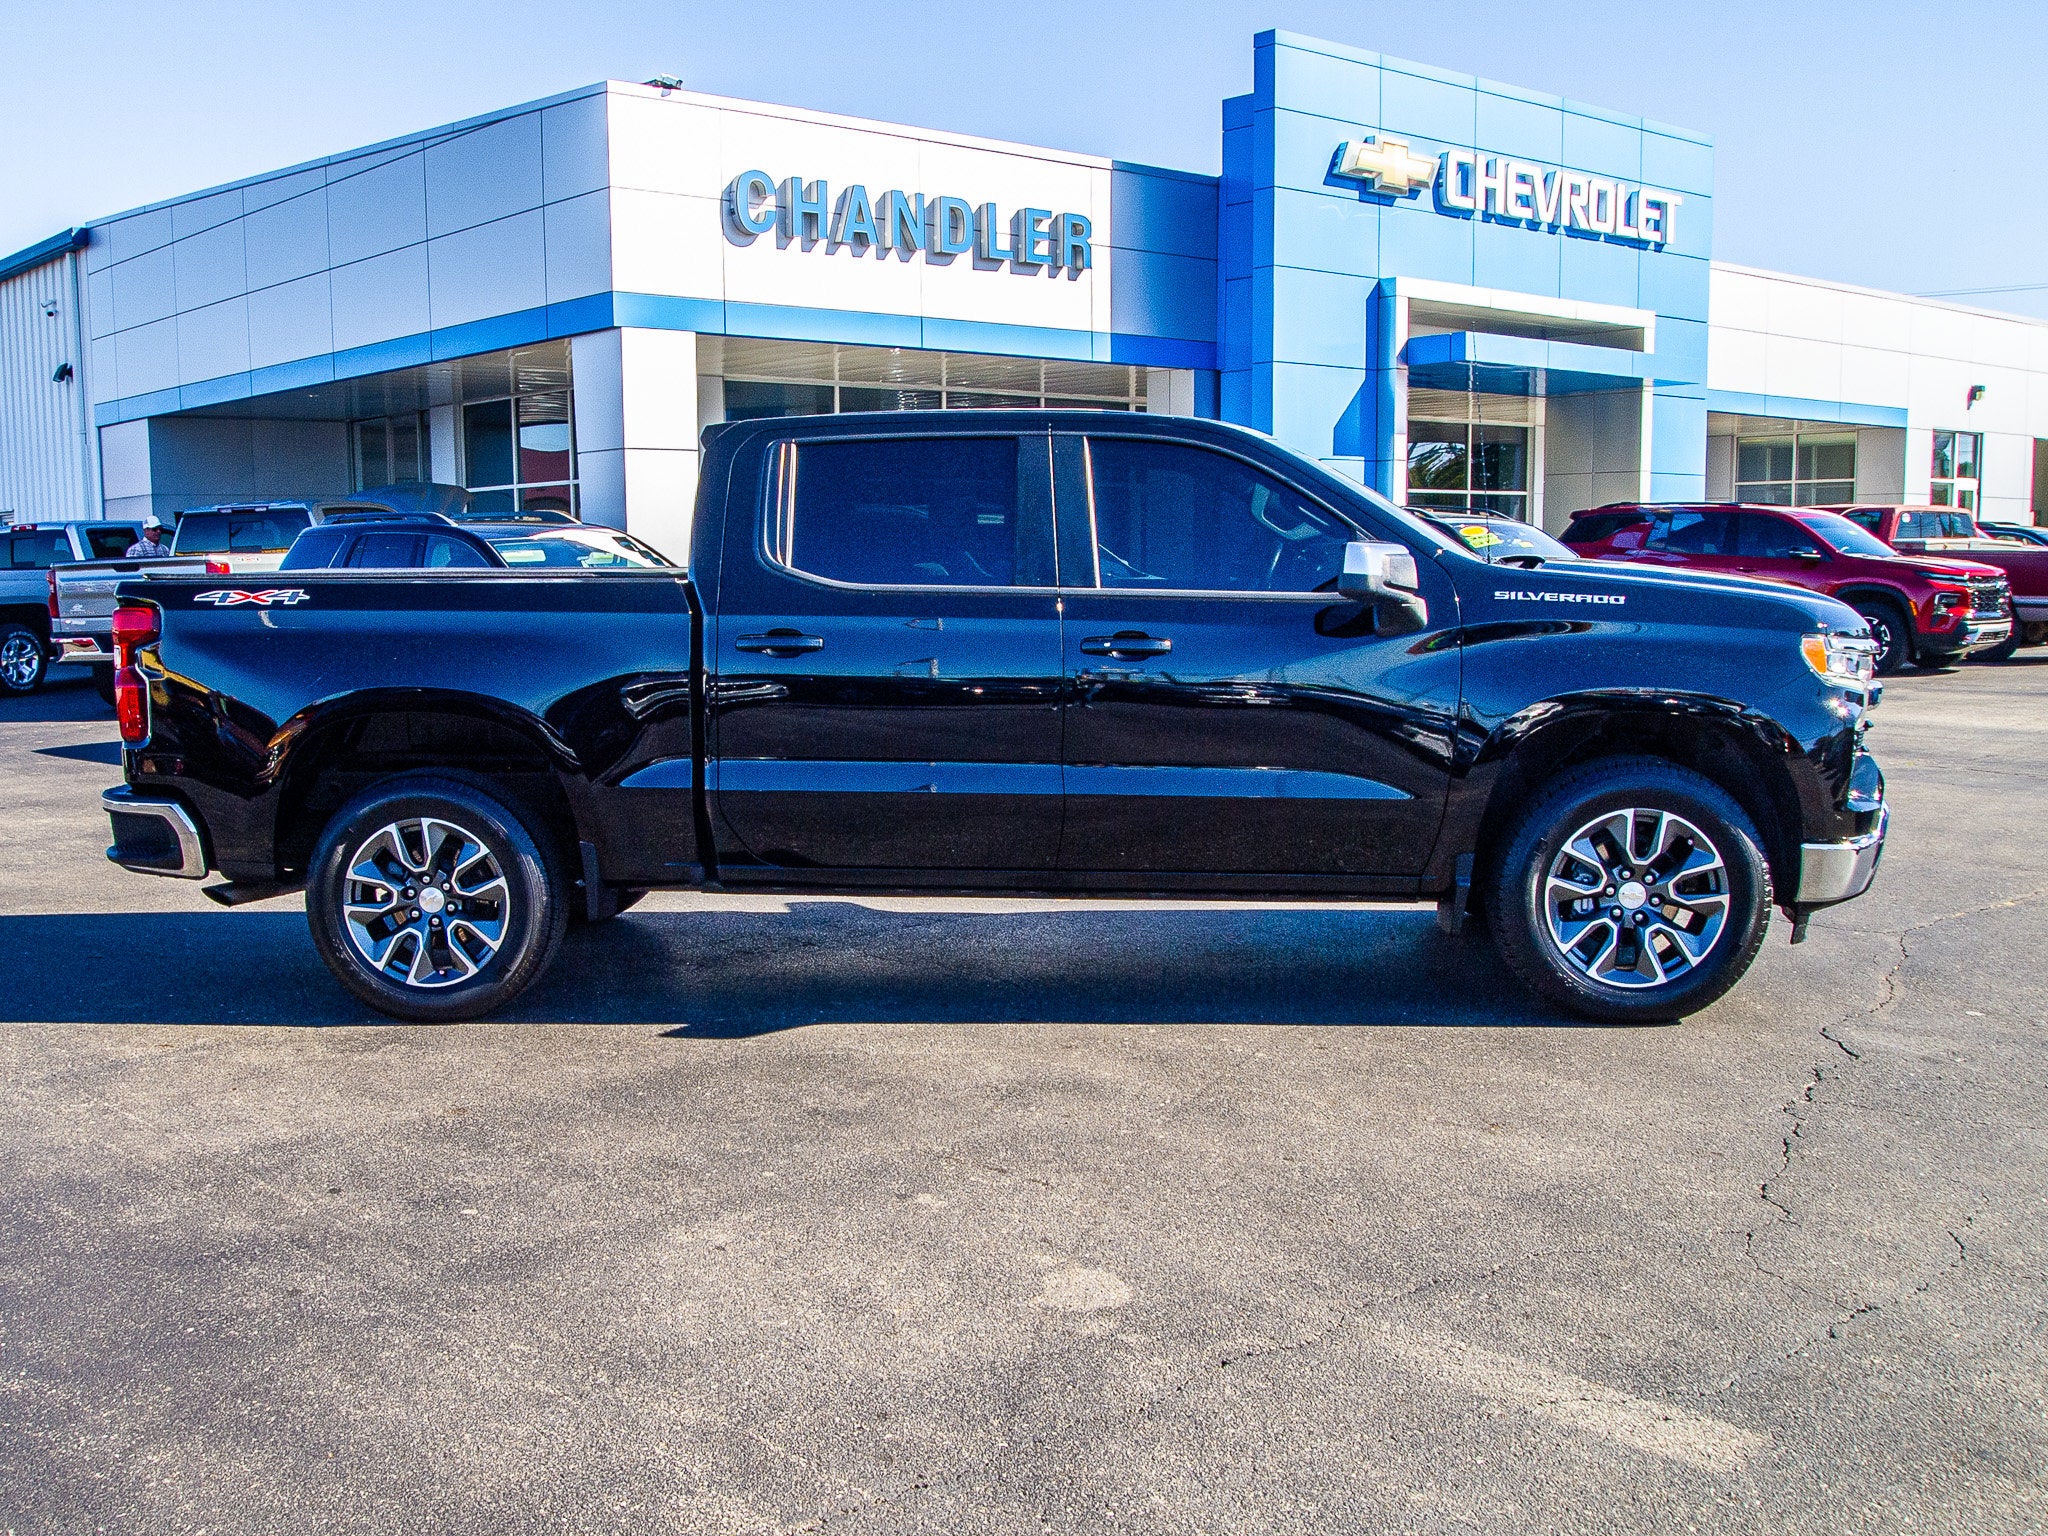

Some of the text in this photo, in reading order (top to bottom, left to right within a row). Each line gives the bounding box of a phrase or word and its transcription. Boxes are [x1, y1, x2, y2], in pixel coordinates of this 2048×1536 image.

[724, 169, 1092, 269] CHANDLER
[1440, 150, 1683, 244] CHEVROLET
[1494, 590, 1626, 604] SILVERADO
